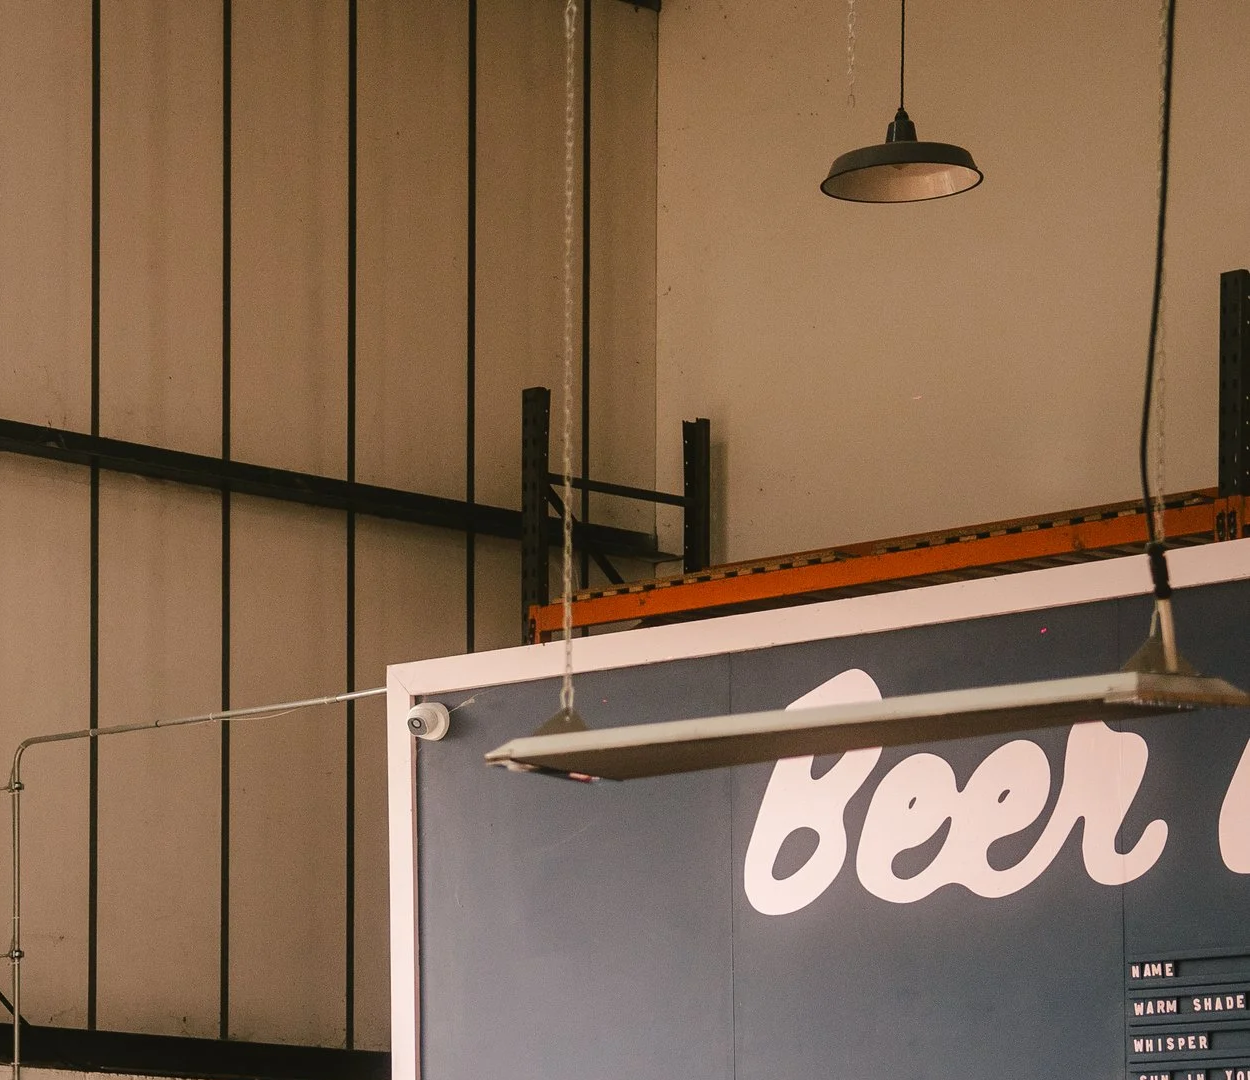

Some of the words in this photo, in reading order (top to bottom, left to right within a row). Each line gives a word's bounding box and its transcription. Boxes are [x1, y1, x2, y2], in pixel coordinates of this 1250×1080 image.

[743, 668, 1169, 916] Beer
[1131, 963, 1174, 978] NAME
[1133, 999, 1177, 1016] WARM
[1192, 994, 1245, 1012] SHADE
[1133, 1035, 1208, 1053] WHISPER
